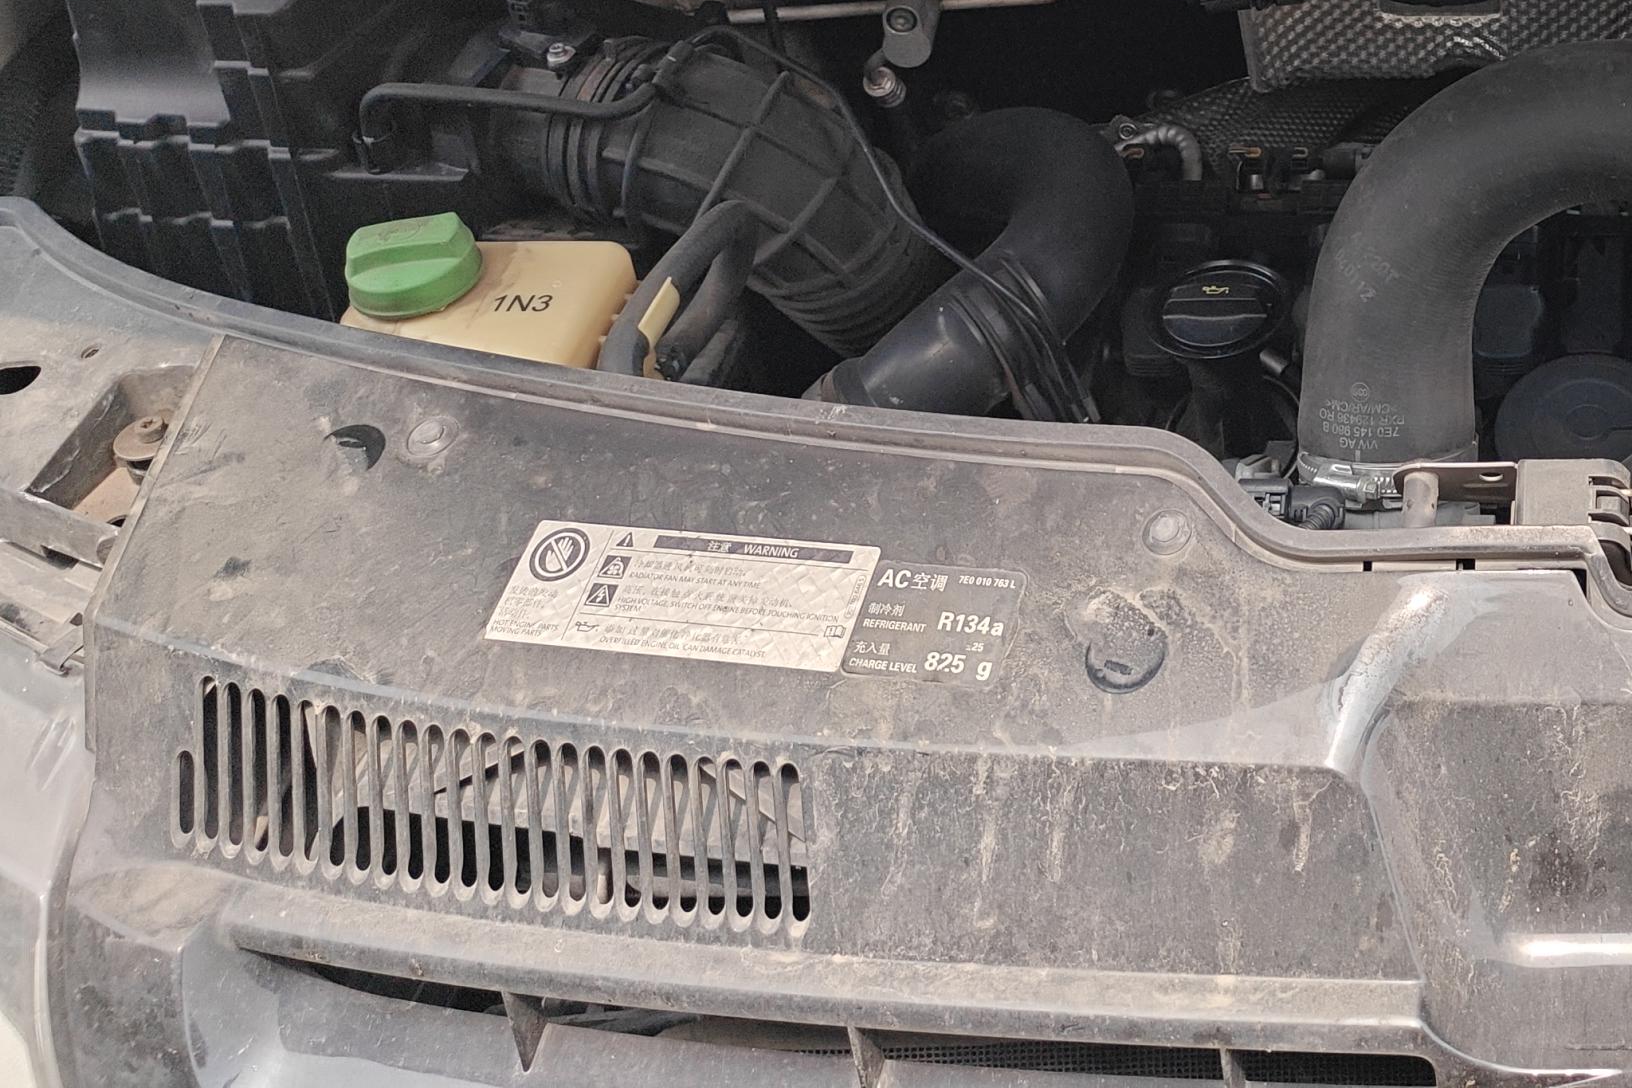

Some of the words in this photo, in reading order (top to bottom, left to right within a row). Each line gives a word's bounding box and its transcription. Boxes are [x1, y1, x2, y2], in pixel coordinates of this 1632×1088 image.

[493, 294, 553, 312] 1N3
[1354, 426, 1372, 437] 145
[1377, 426, 1400, 437] 7E0
[1340, 437, 1356, 449] AG
[1358, 439, 1378, 450] VW
[707, 540, 731, 552] 注意
[743, 544, 800, 558] WARNING
[959, 575, 975, 585] 7E0
[976, 576, 991, 586] 010
[993, 578, 1010, 588] 763
[1010, 580, 1016, 589] L
[867, 602, 905, 616] 制冷剂
[862, 618, 927, 632] REFRIGERANT
[937, 611, 1004, 637] R134a
[854, 641, 891, 656] 充入量
[849, 657, 887, 671] CHARGE
[889, 662, 917, 673] LEVEL
[924, 651, 966, 674] 825
[975, 661, 993, 681] g
